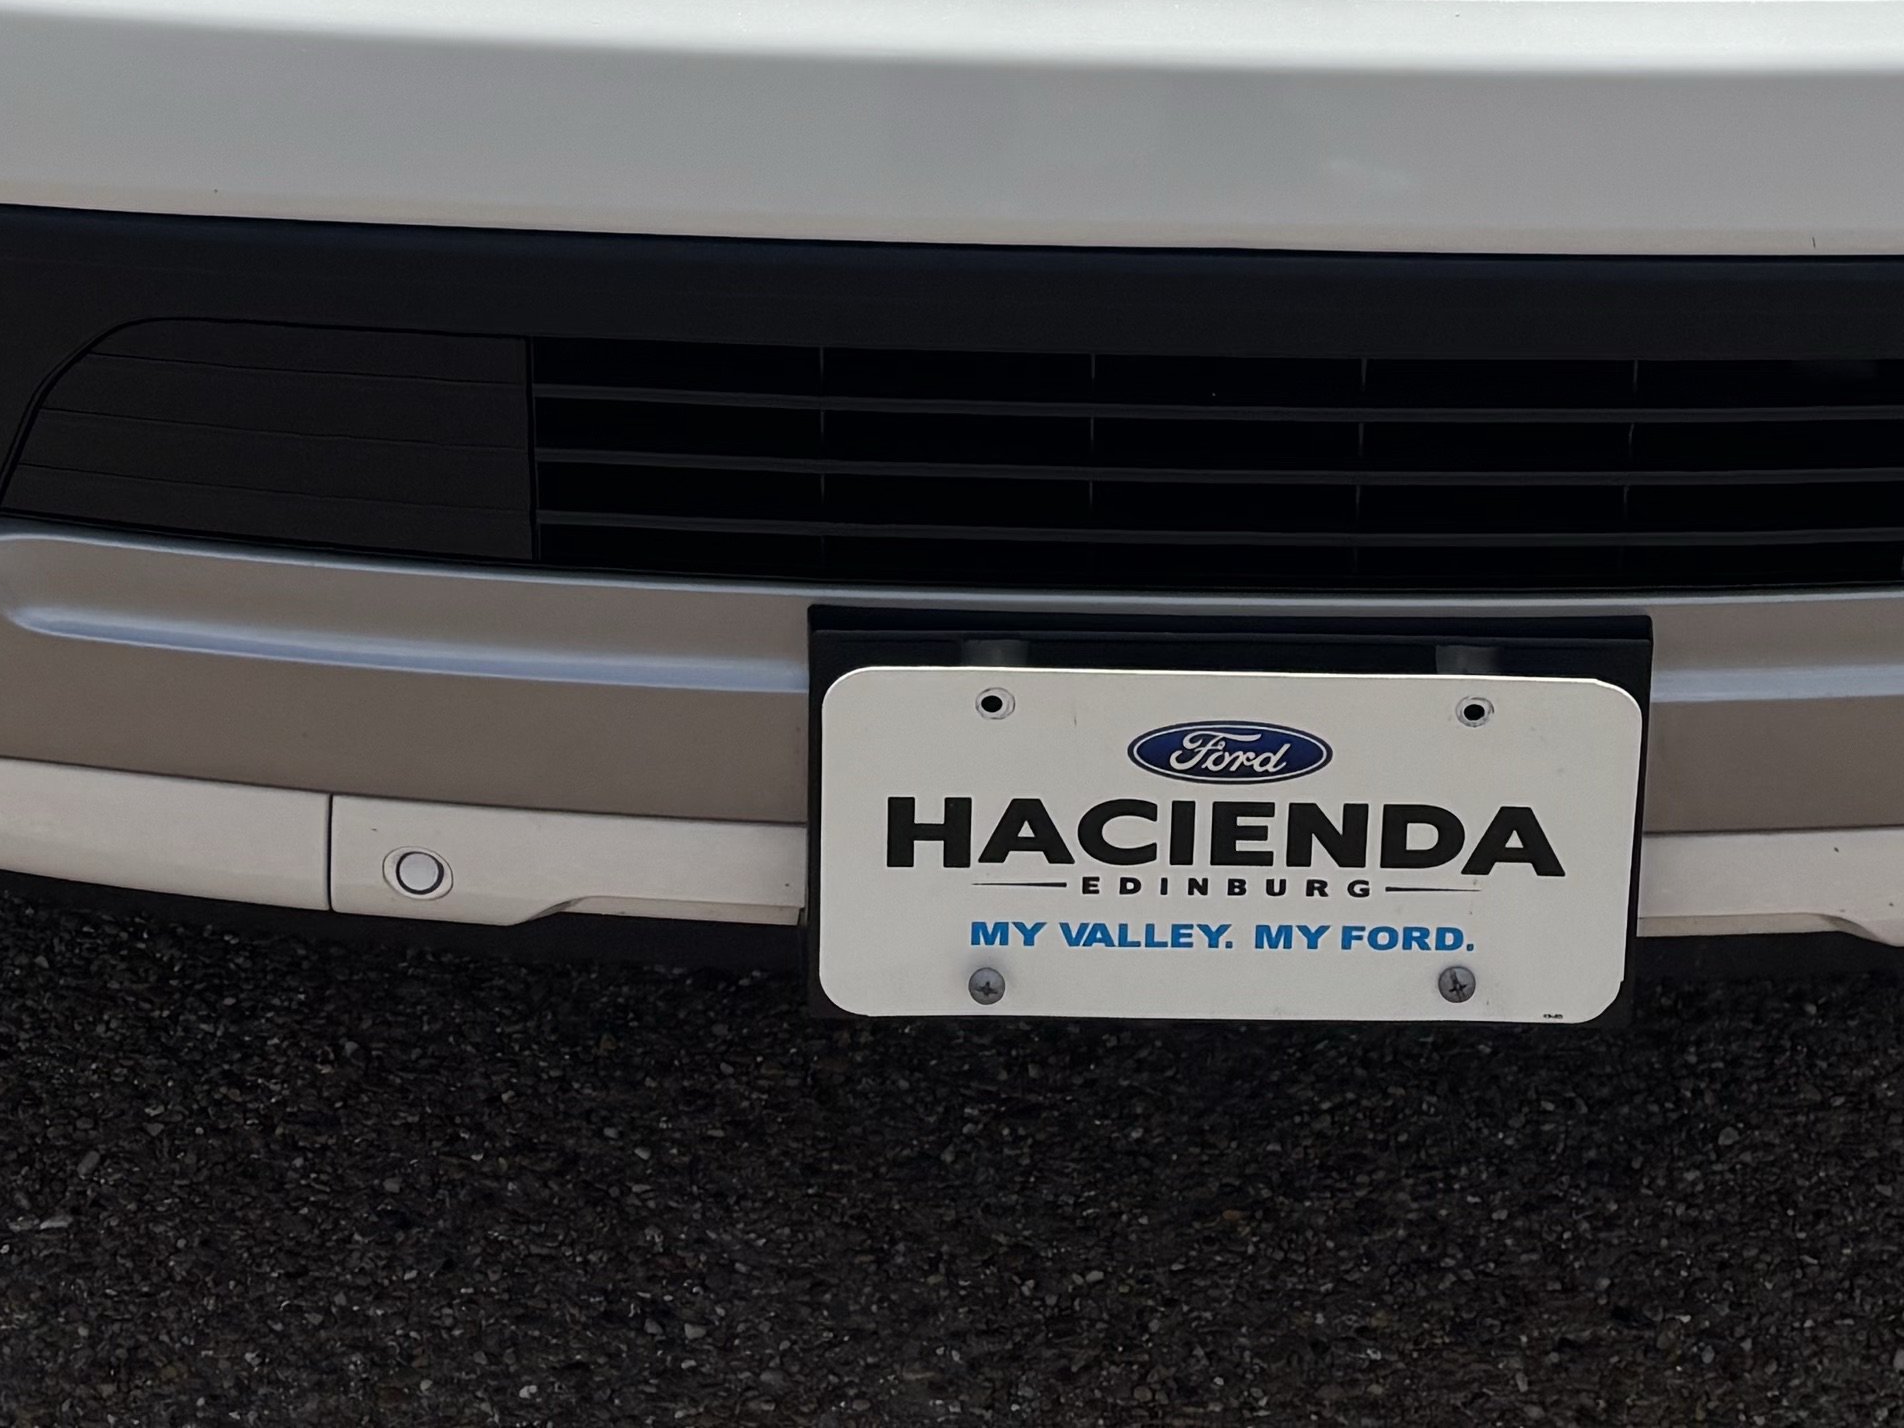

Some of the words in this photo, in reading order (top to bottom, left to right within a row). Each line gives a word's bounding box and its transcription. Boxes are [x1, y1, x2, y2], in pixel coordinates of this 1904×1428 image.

[1169, 730, 1291, 773] Ford
[886, 796, 1566, 877] HACIENDA
[1081, 875, 1371, 898] EDINBURG
[970, 921, 1047, 947] MY
[1059, 922, 1234, 949] VALLEY.
[1254, 924, 1332, 951] MY
[1340, 925, 1475, 953] FORD.
